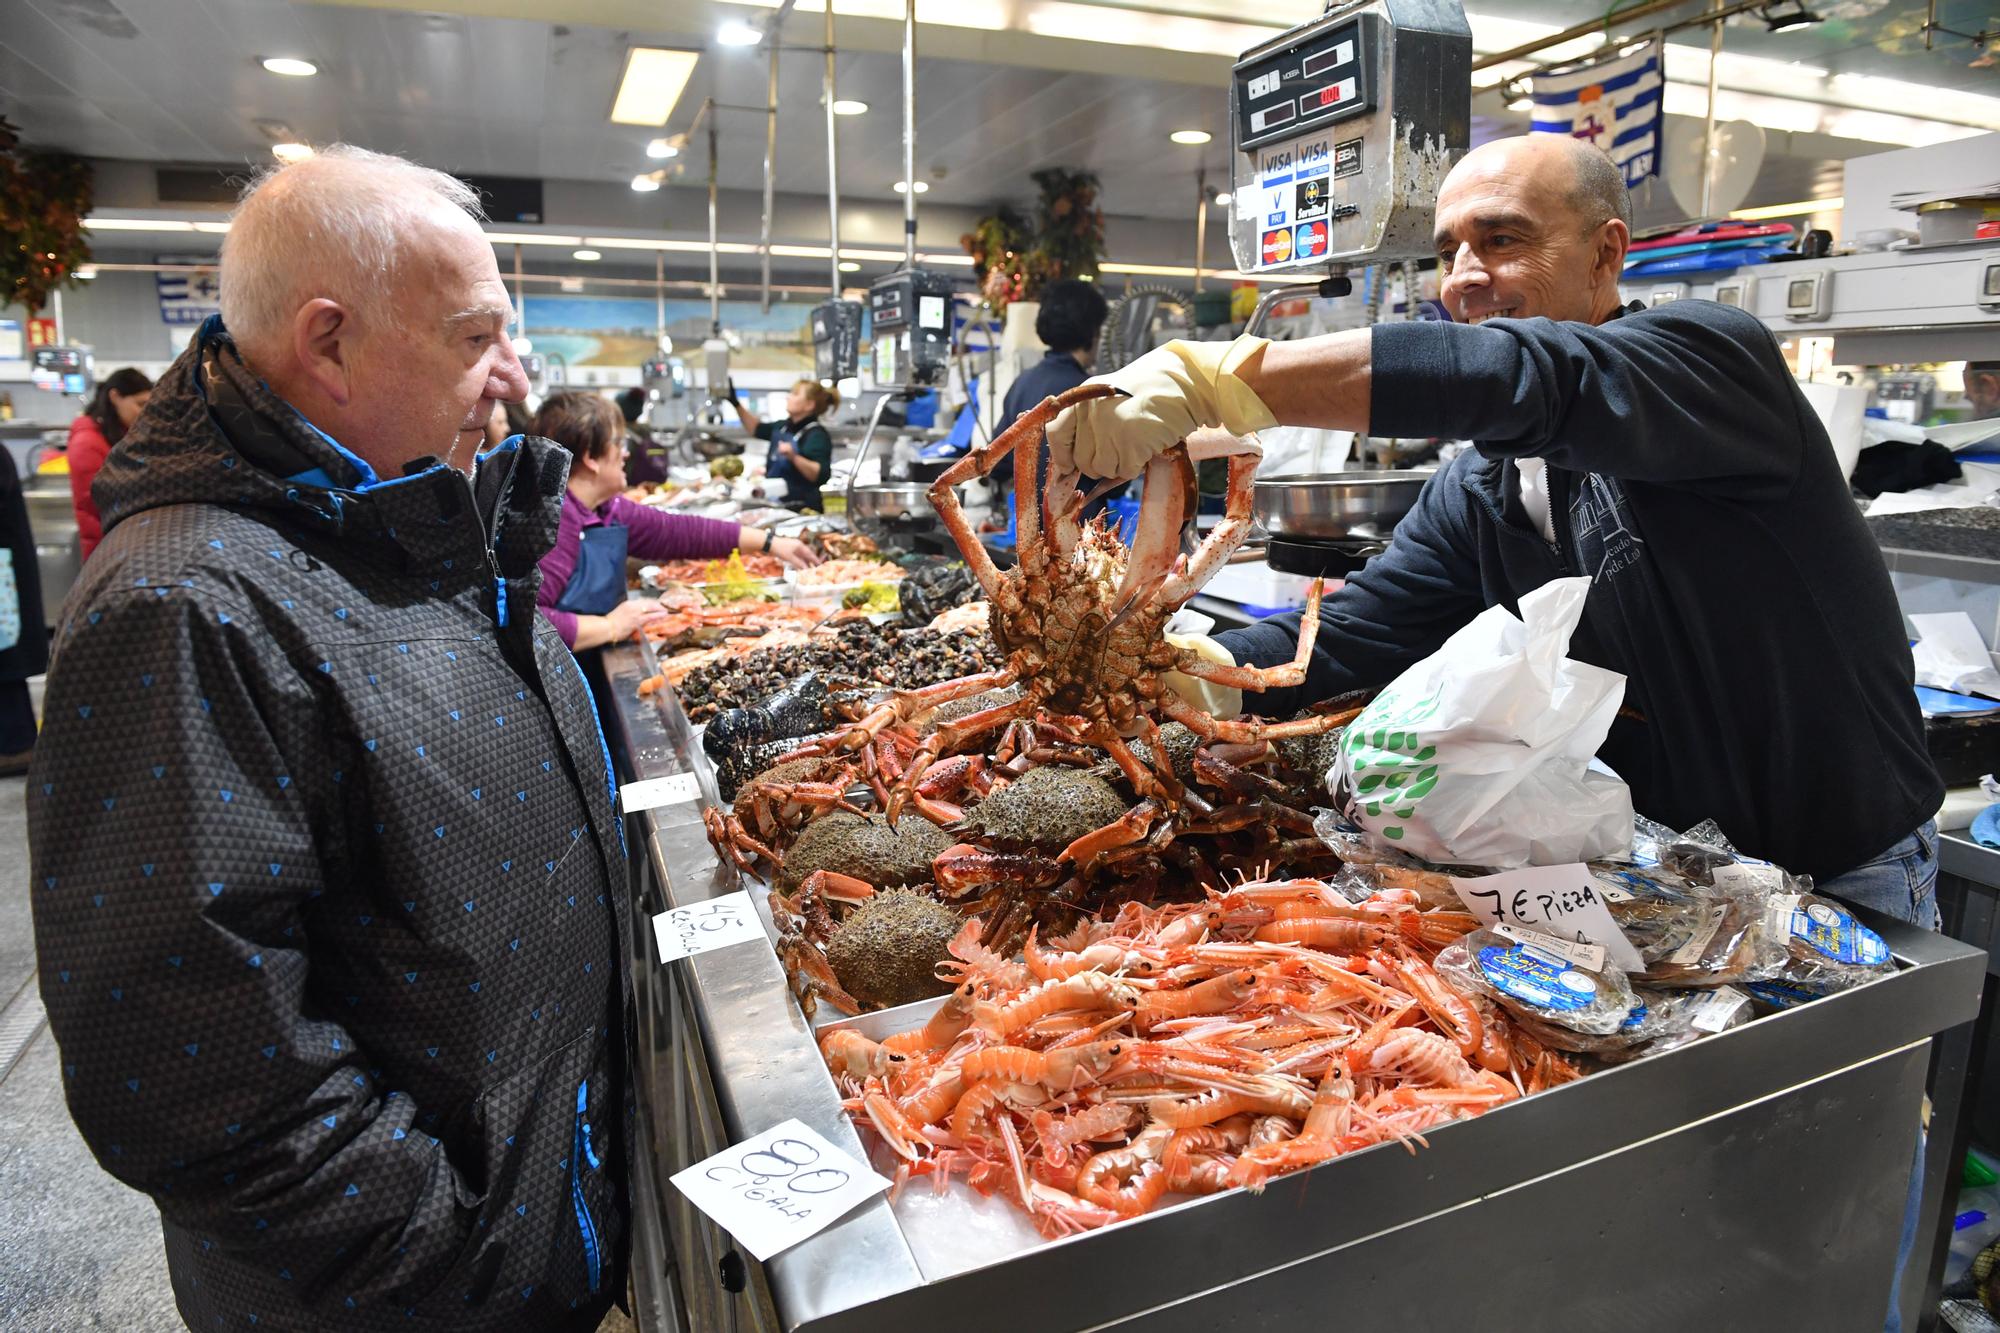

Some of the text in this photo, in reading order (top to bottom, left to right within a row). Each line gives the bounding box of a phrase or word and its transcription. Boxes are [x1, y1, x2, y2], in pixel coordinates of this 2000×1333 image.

[1266, 151, 1292, 174] VISA
[1301, 141, 1329, 164] VISA
[1271, 213, 1283, 225] PAY
